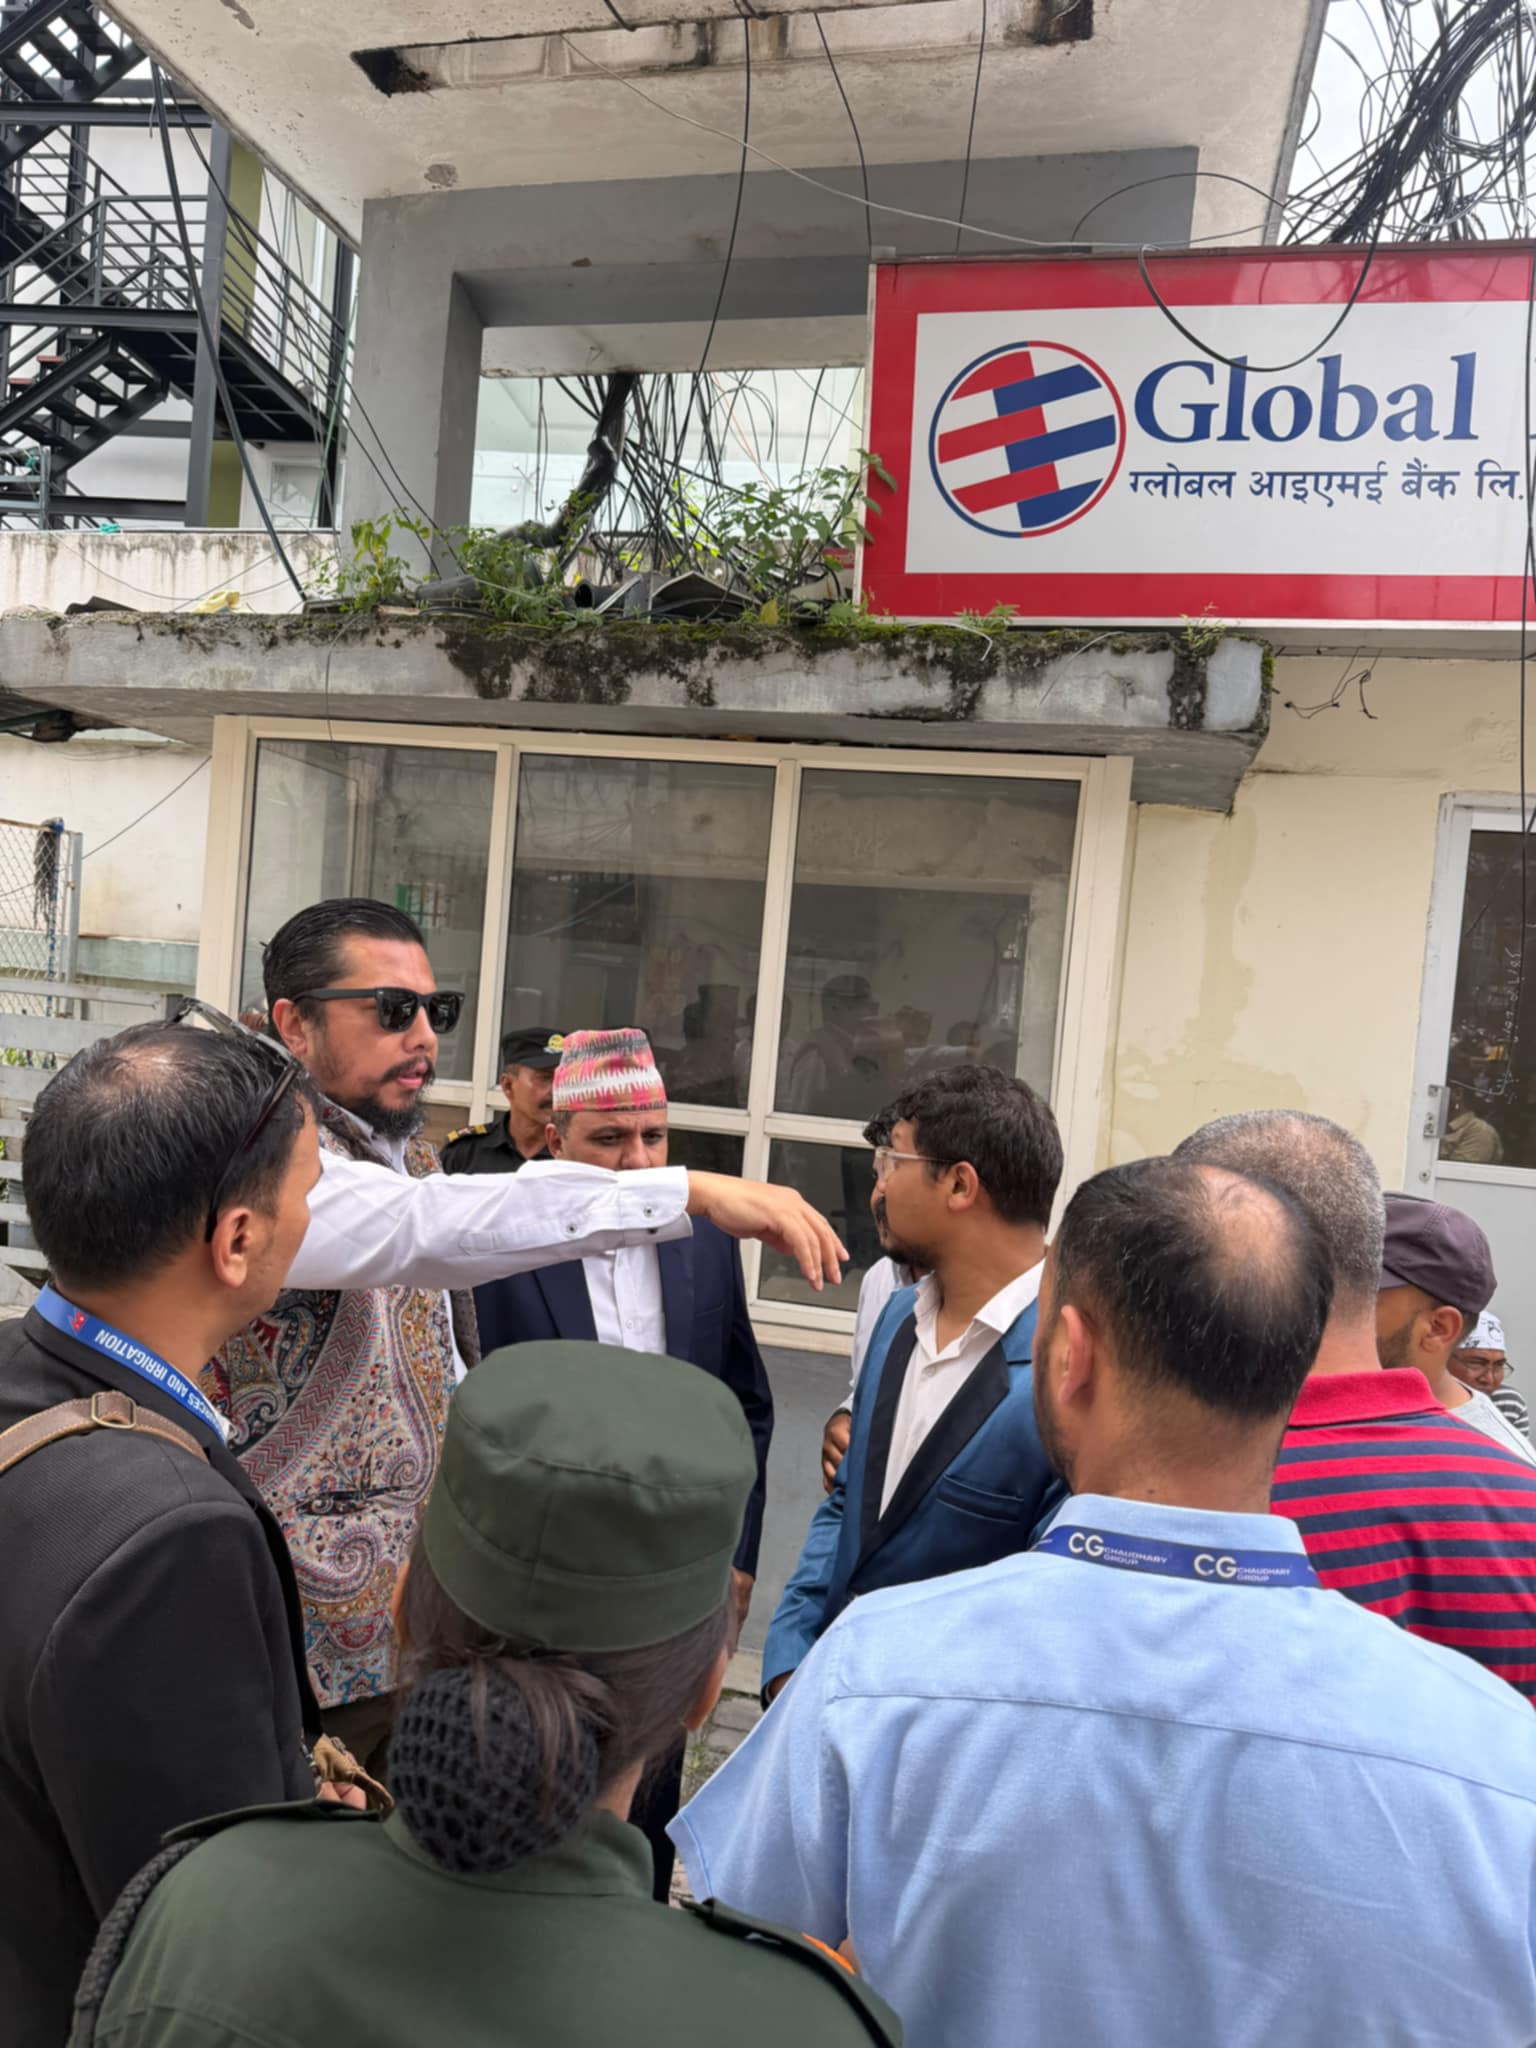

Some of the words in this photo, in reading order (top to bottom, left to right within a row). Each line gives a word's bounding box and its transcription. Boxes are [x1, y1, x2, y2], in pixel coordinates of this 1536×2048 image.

[1134, 352, 1478, 443] Global
[1129, 463, 1237, 500] ग्लोबल
[1250, 461, 1388, 507] आइएमई
[1401, 458, 1459, 500] बैंक
[1475, 459, 1525, 500] लि.
[94, 1329, 168, 1381] IRRIGATION
[168, 1373, 189, 1398] AND
[1068, 1532, 1104, 1557] CG
[1104, 1547, 1168, 1564] CHAUDHARY
[1104, 1554, 1139, 1566] GROUP
[1193, 1554, 1237, 1578] CG
[1237, 1567, 1291, 1577] CHAUDHARY
[1237, 1574, 1270, 1583] GROUP
